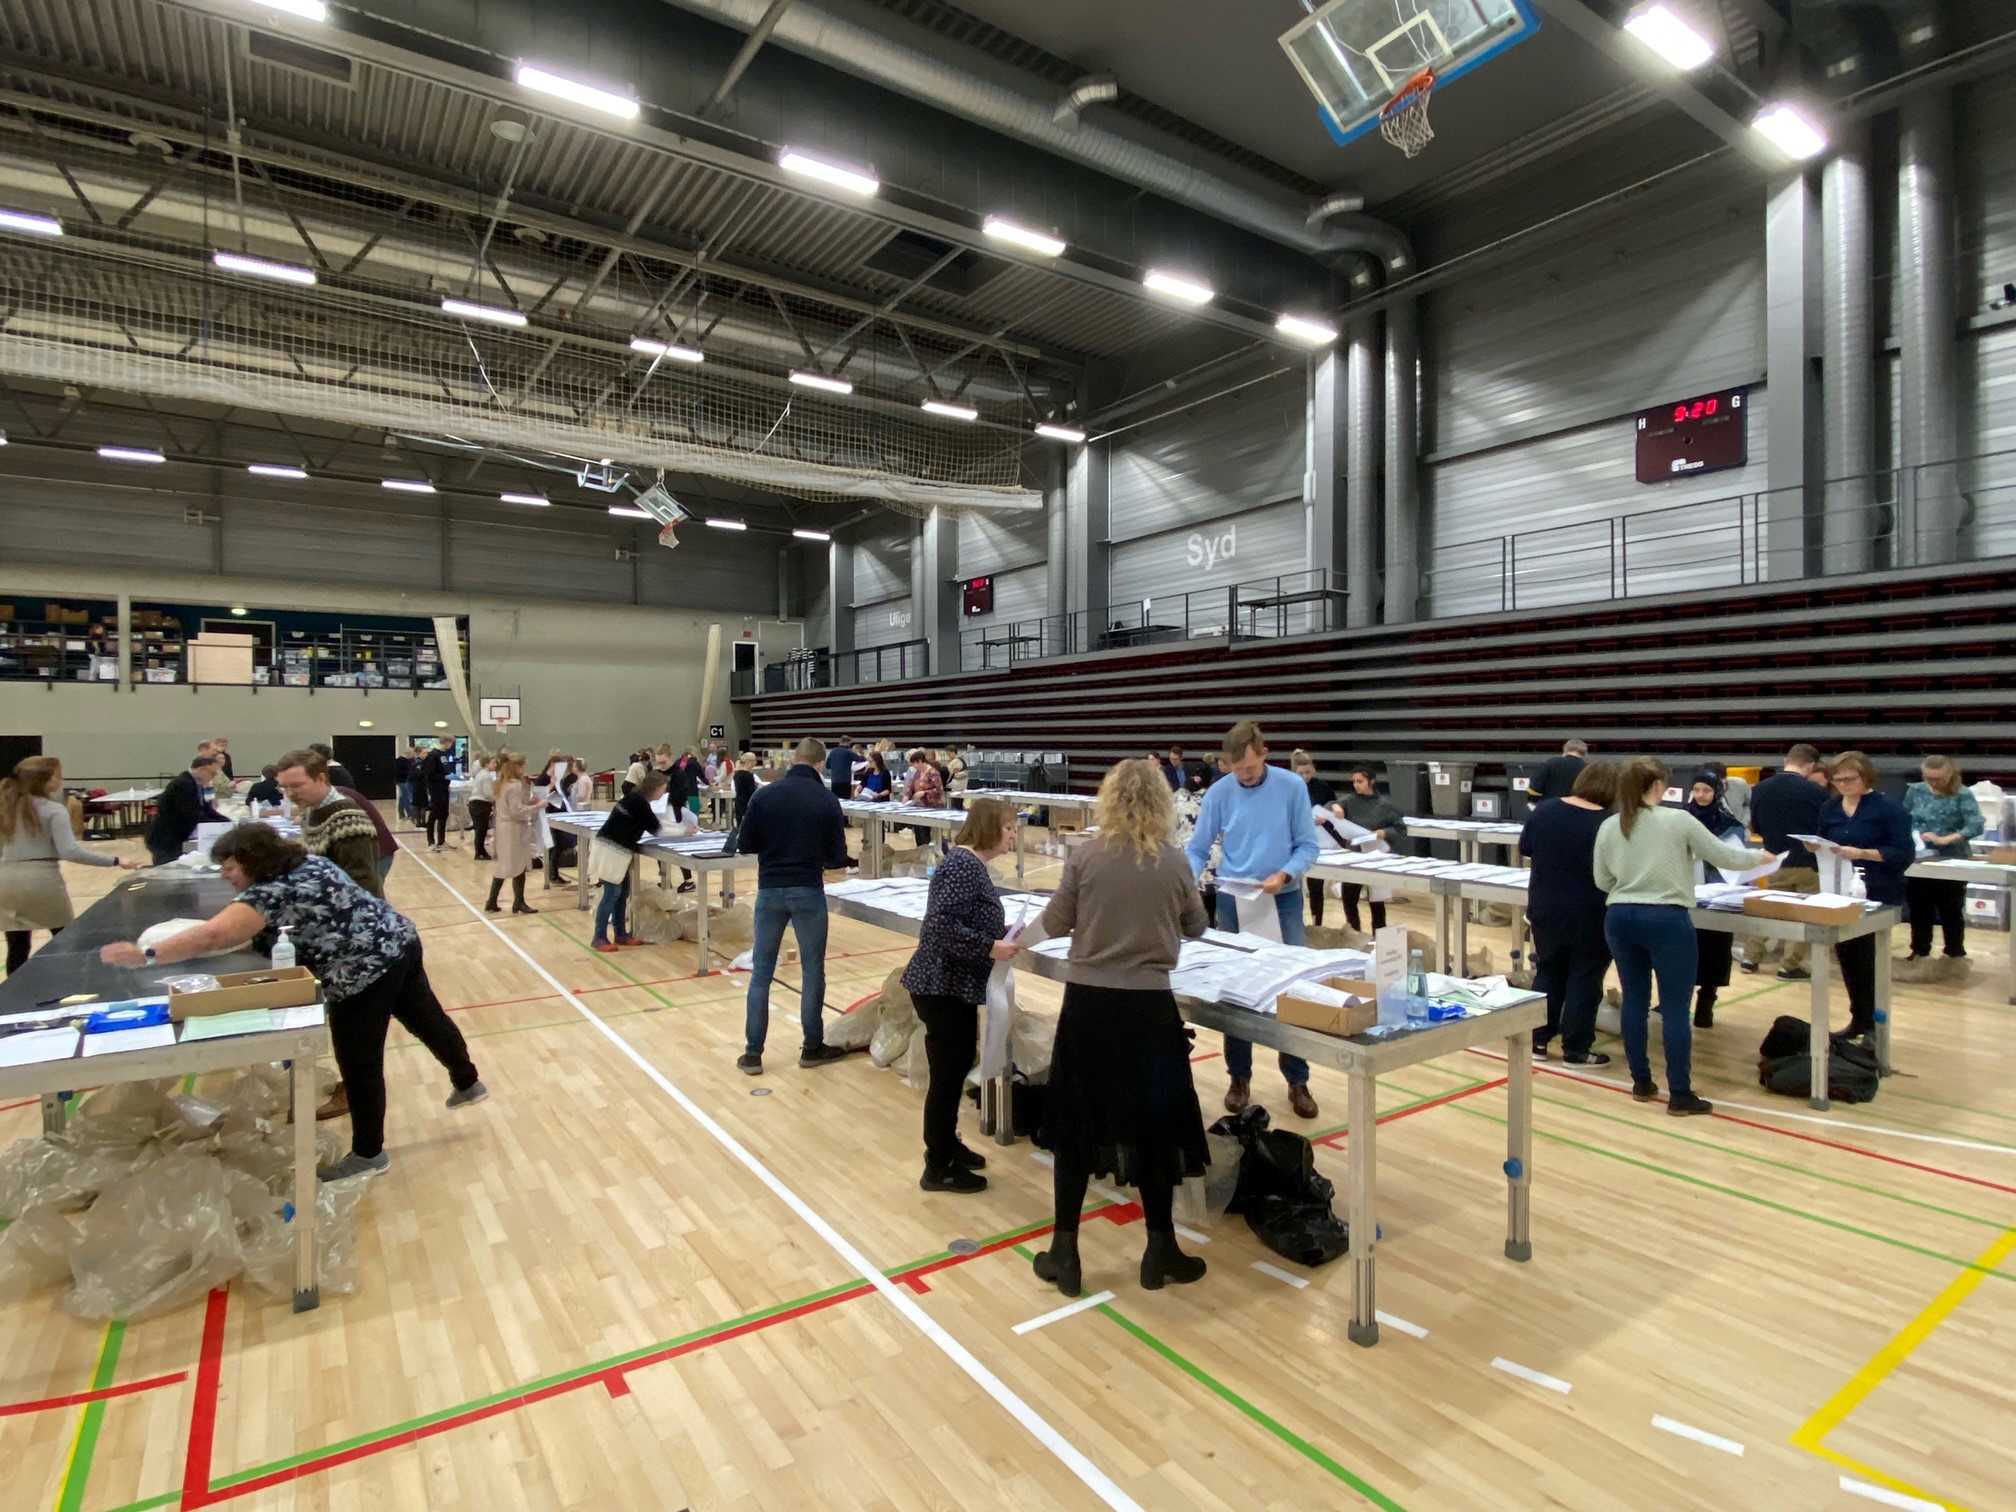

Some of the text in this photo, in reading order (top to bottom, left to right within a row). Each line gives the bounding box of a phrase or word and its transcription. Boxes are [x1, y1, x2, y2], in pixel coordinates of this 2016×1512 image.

[1731, 395, 1741, 408] G
[1638, 417, 1647, 430] H
[1187, 524, 1236, 571] Syd
[710, 727, 723, 736] C1
